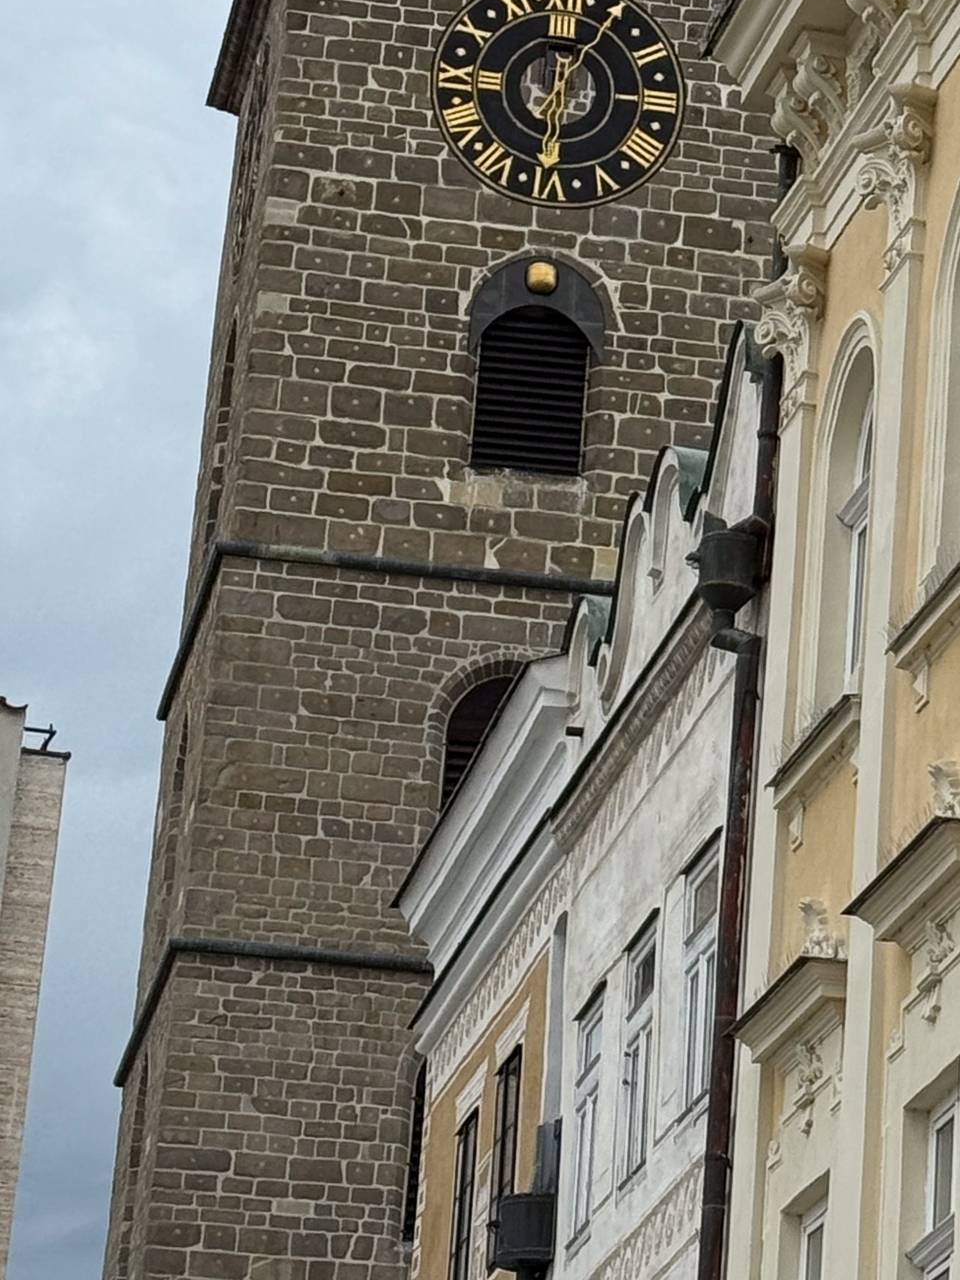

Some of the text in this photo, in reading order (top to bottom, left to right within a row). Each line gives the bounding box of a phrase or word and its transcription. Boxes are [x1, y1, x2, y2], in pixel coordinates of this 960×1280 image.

[454, 14, 493, 47] X
[632, 42, 668, 67] II
[438, 61, 474, 91] IX
[643, 88, 677, 114] III
[442, 102, 480, 149] VIII
[474, 142, 513, 186] VII
[621, 128, 664, 169] IIII
[531, 166, 566, 201] VI
[595, 164, 621, 196] V
